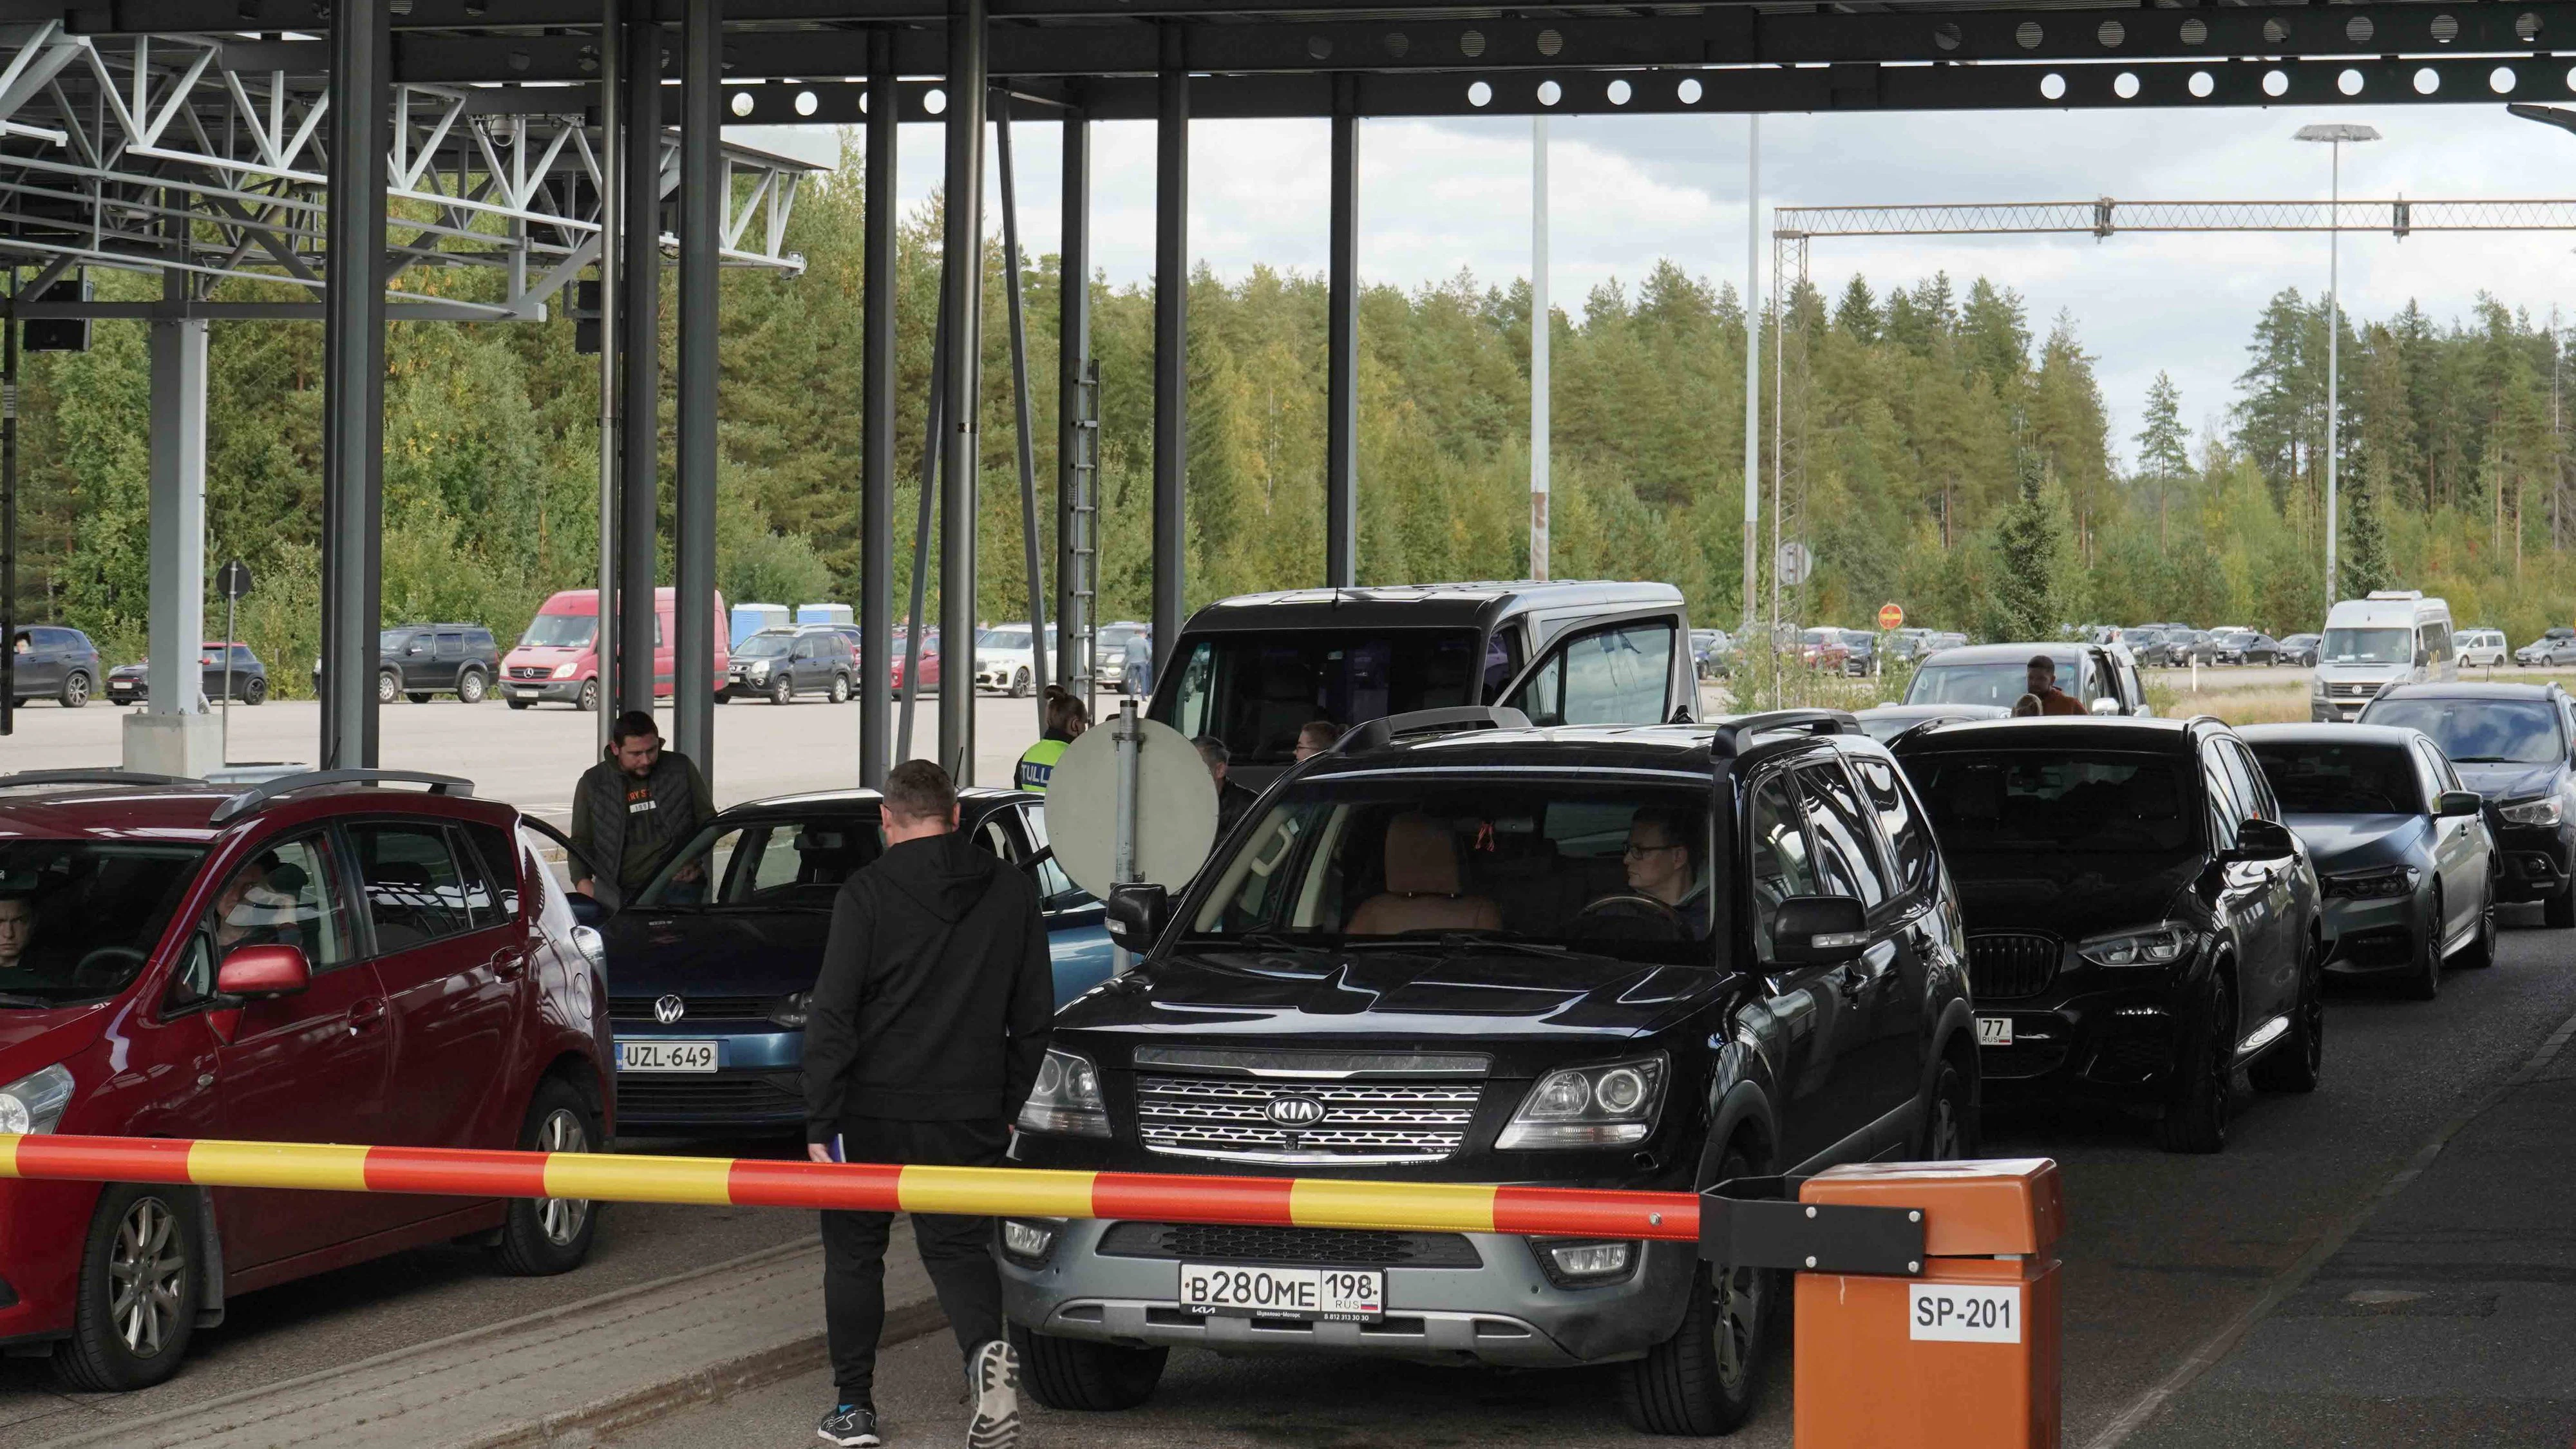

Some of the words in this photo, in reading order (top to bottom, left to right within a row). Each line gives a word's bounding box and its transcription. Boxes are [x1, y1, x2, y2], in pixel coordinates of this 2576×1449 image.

[1021, 764, 1048, 784] TULL
[1983, 1020, 2003, 1036] 77
[627, 1047, 711, 1067] UZL-649
[1275, 1102, 1313, 1119] KIA
[1325, 1273, 1372, 1300] 198
[1336, 1300, 1359, 1309] RUS
[1917, 1296, 2010, 1329] SP-201
